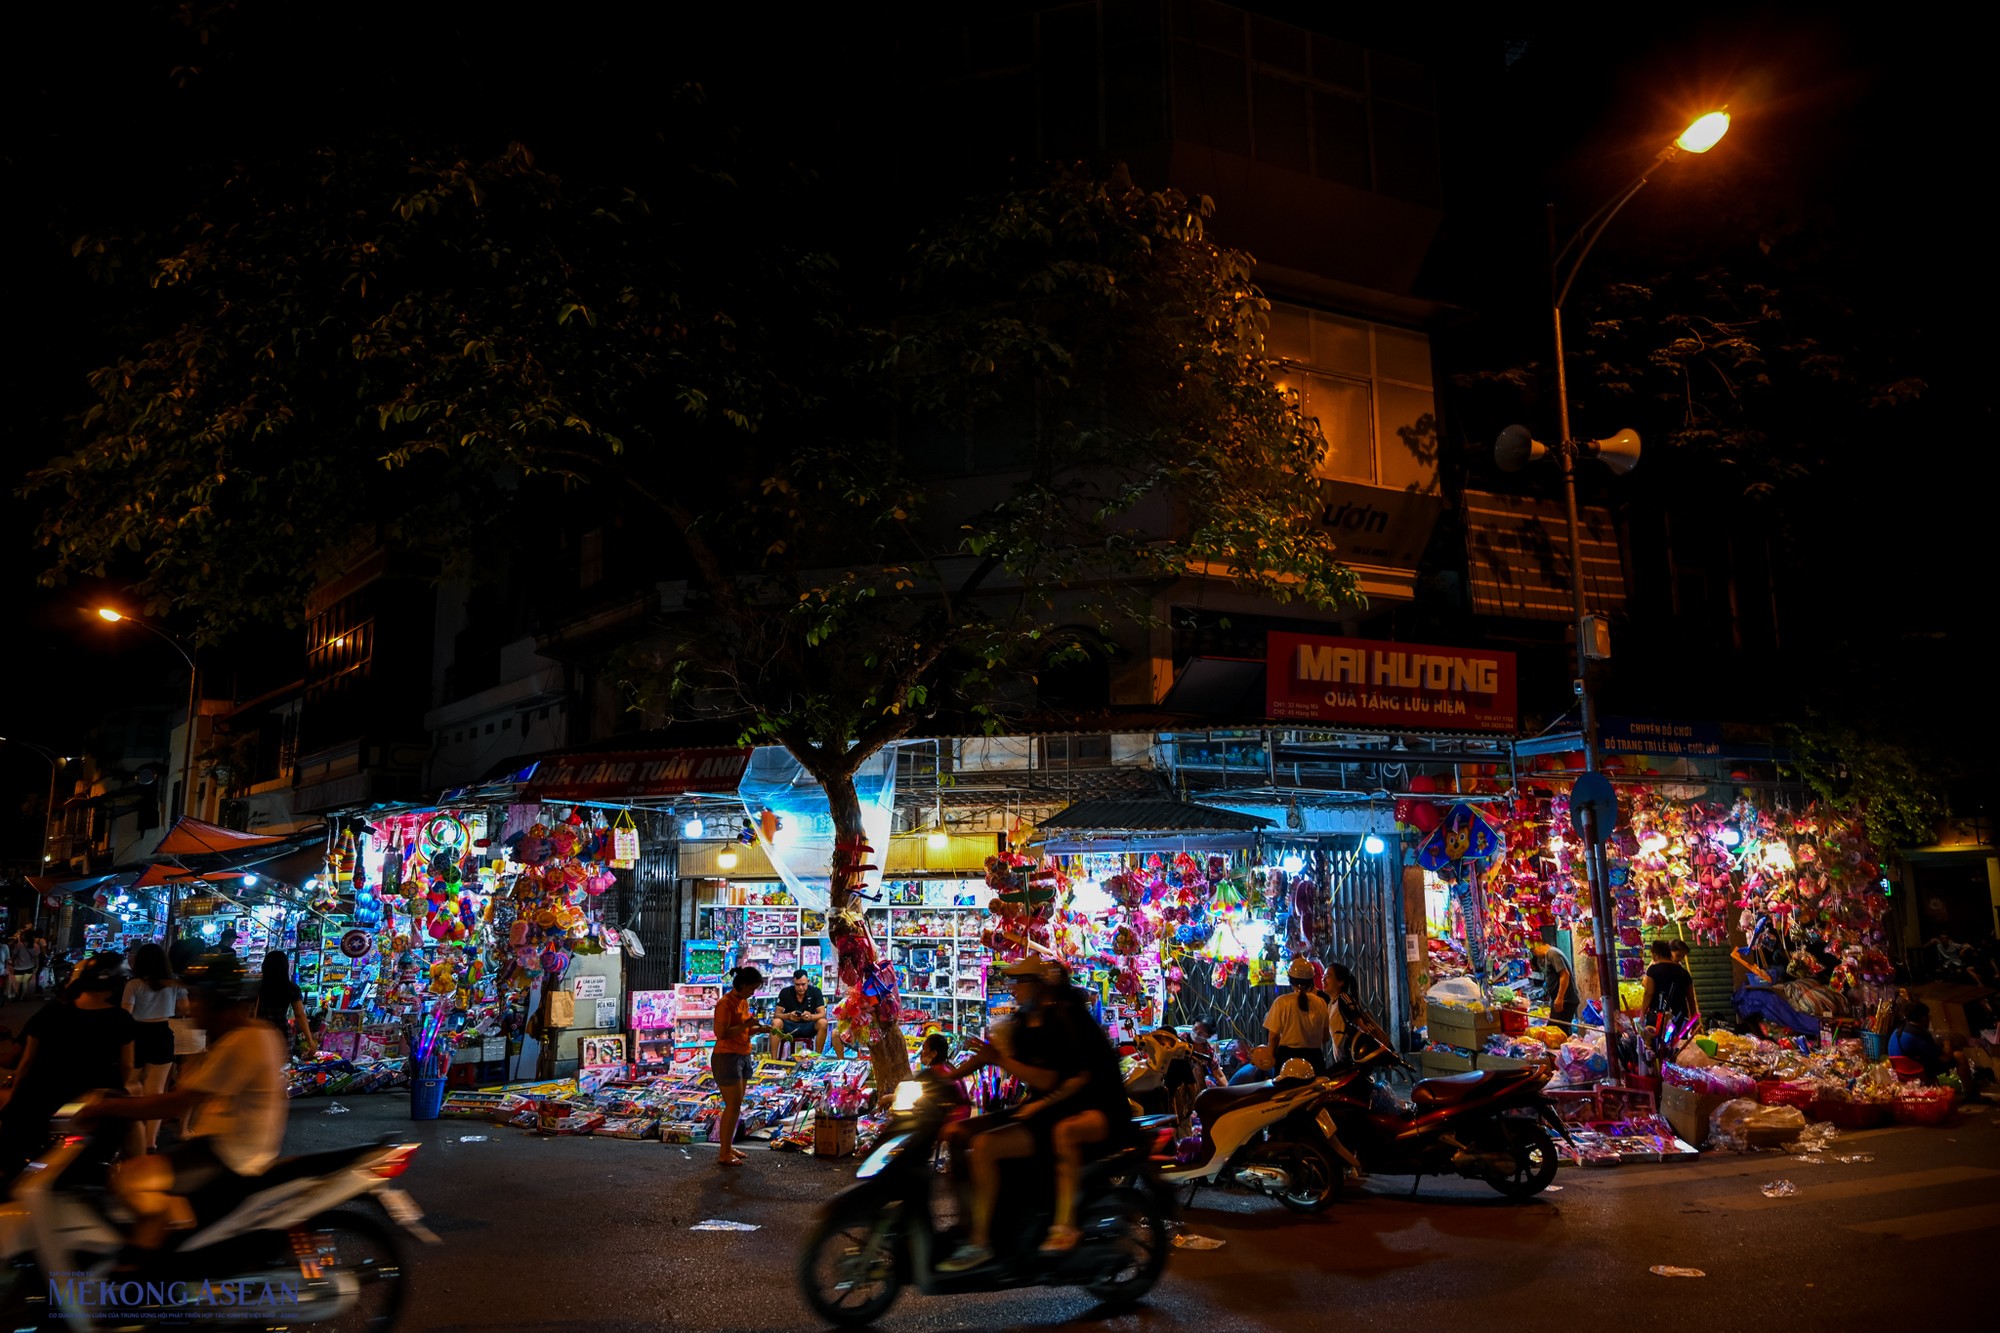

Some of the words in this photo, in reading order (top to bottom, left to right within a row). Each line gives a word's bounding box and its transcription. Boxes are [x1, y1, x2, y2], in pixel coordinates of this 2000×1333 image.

[1296, 643, 1366, 685] MAI
[1371, 650, 1498, 694] HƯƠNG
[1324, 689, 1357, 709] QUÀ
[1360, 690, 1400, 712] TẶNG
[1404, 695, 1431, 713] LƯU
[1434, 696, 1466, 717] NIỆM
[1629, 721, 1661, 735] CHUYÊN
[1673, 725, 1693, 737] CHƠI
[1617, 739, 1643, 751] TRANG
[532, 758, 574, 787] CỬA
[575, 760, 635, 785] HÀNG
[637, 751, 697, 782] TUẤN
[695, 755, 746, 779] ANH
